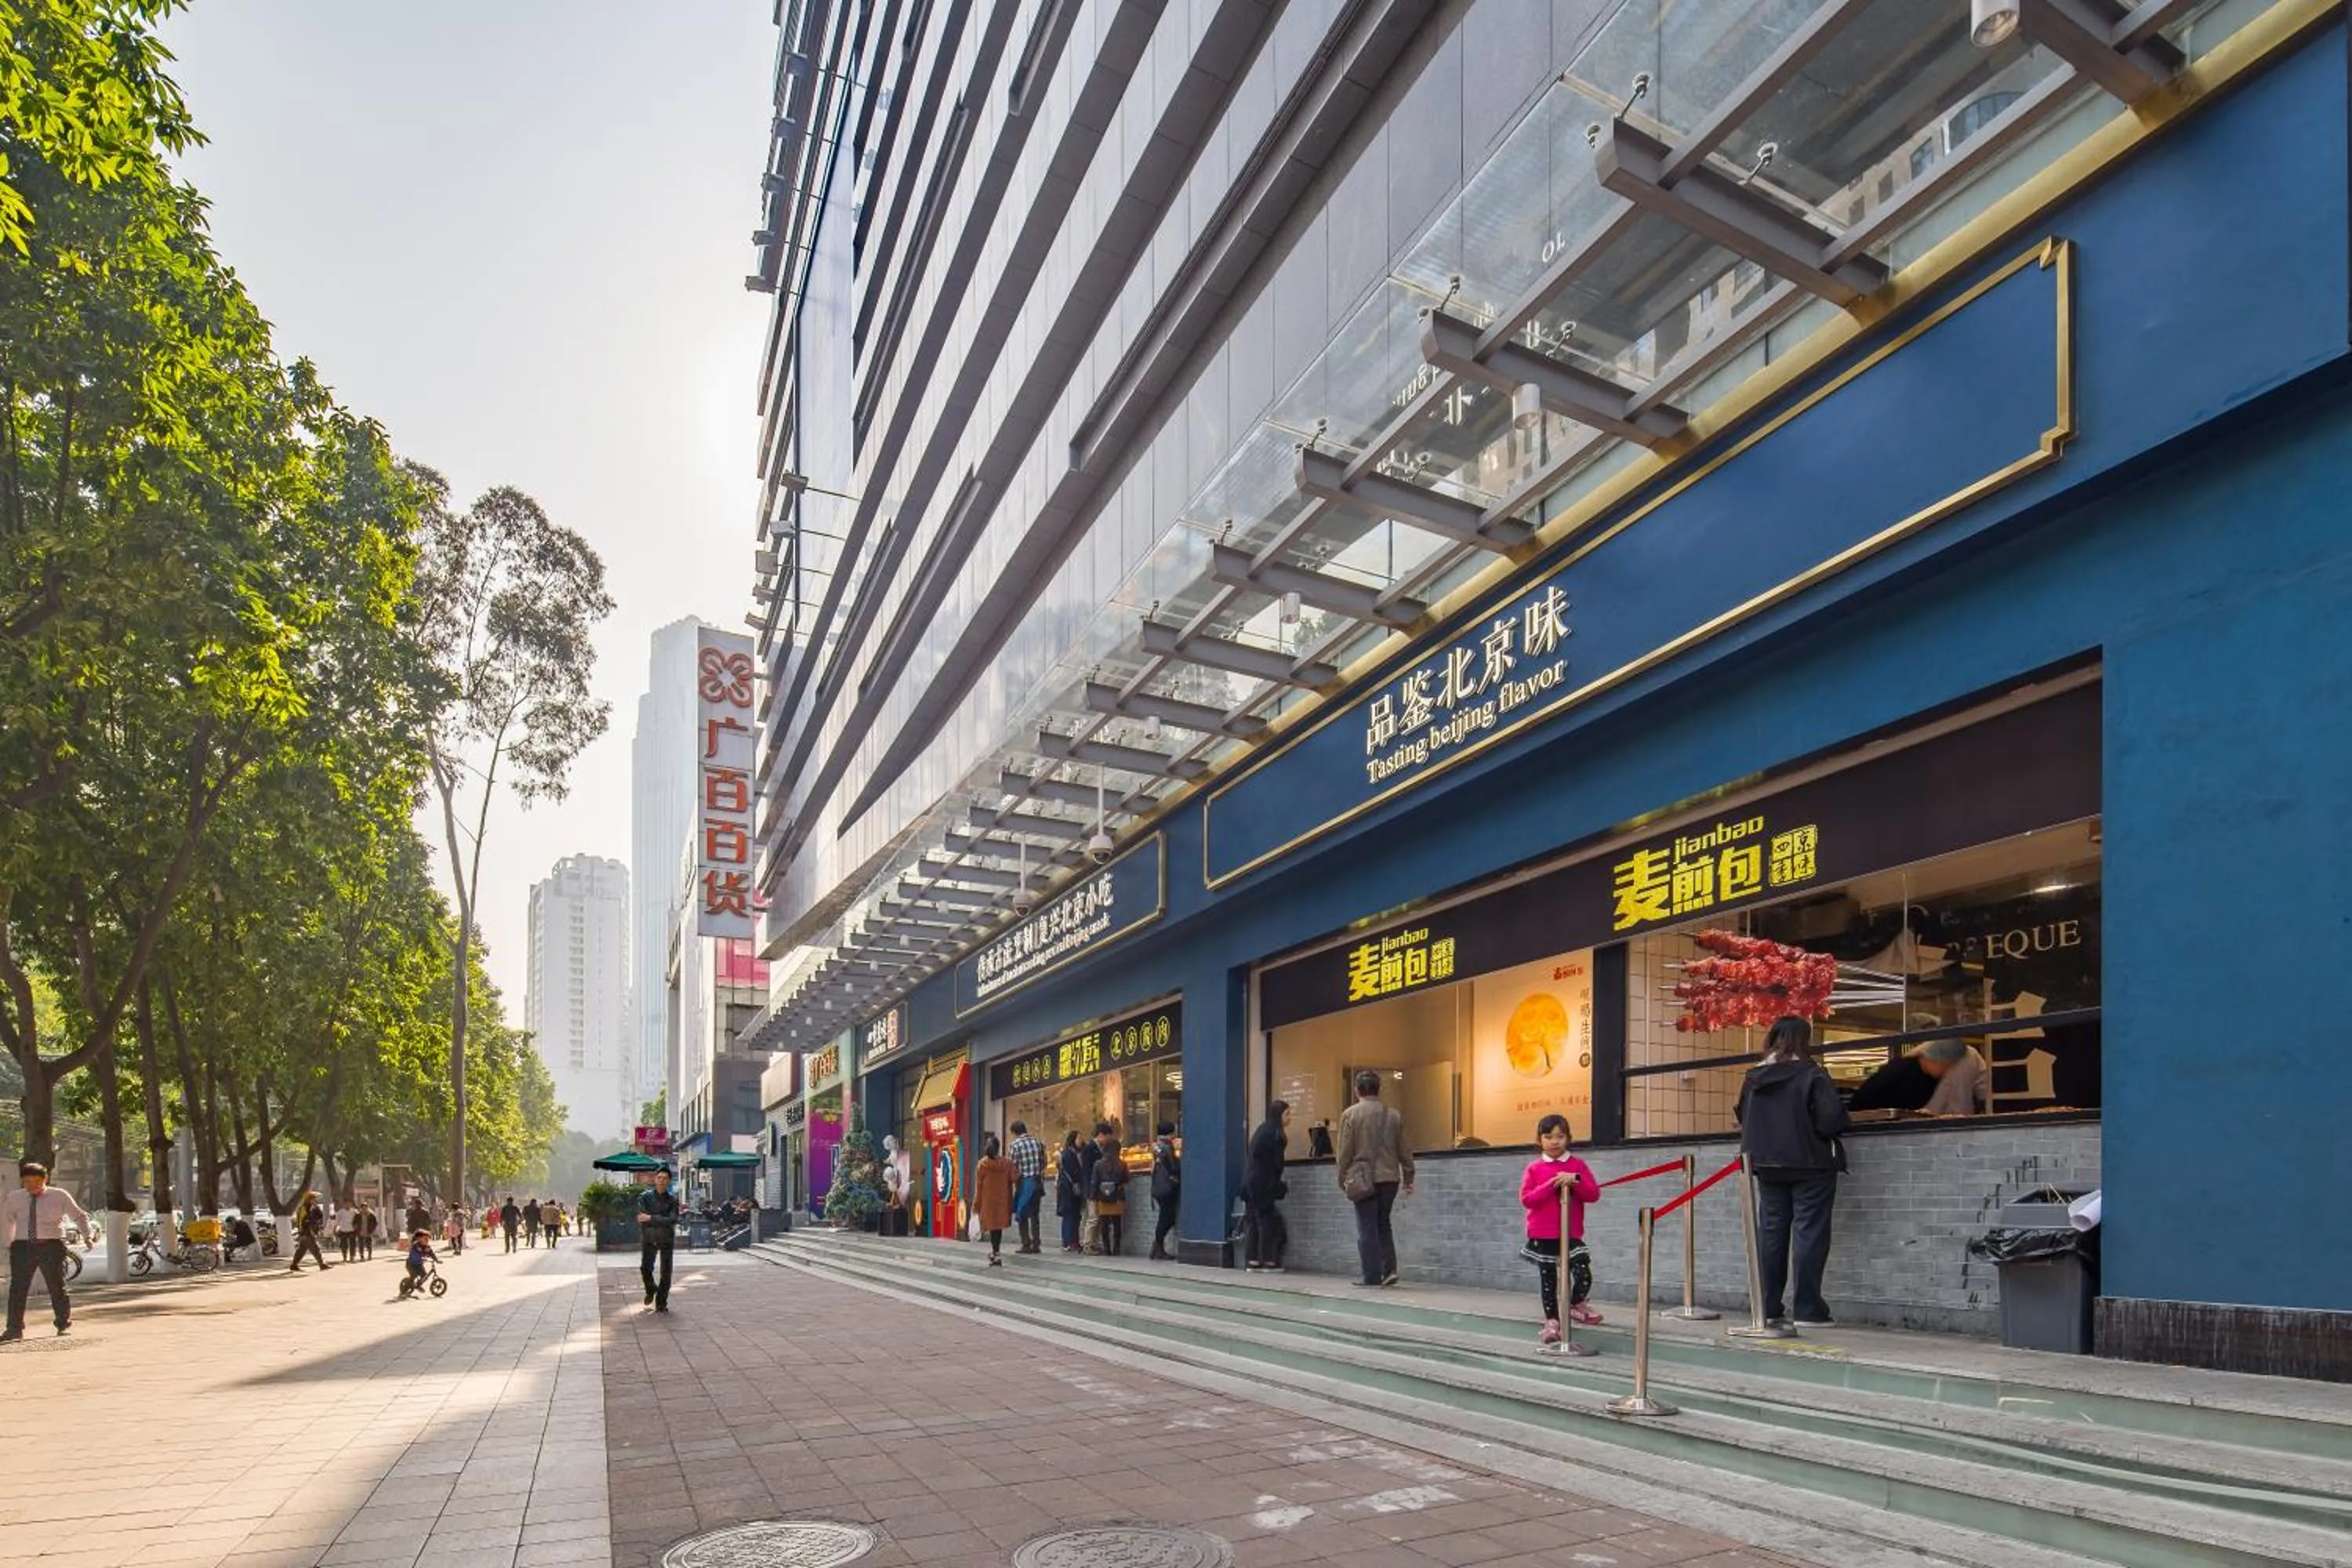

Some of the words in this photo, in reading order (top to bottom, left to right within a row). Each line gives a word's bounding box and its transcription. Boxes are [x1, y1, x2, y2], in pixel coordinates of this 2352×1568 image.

[1367, 586, 1570, 754] 品鉴北京味
[1367, 735, 1429, 783] Tasting
[1429, 699, 1497, 751] beijing
[1499, 659, 1567, 713] flavor
[702, 717, 749, 918] 广百百货
[1673, 815, 1764, 864] jianbao
[1613, 844, 1762, 931] 麦煎包
[1348, 943, 1428, 1003] 麦煎包
[1381, 928, 1429, 956] jianbao
